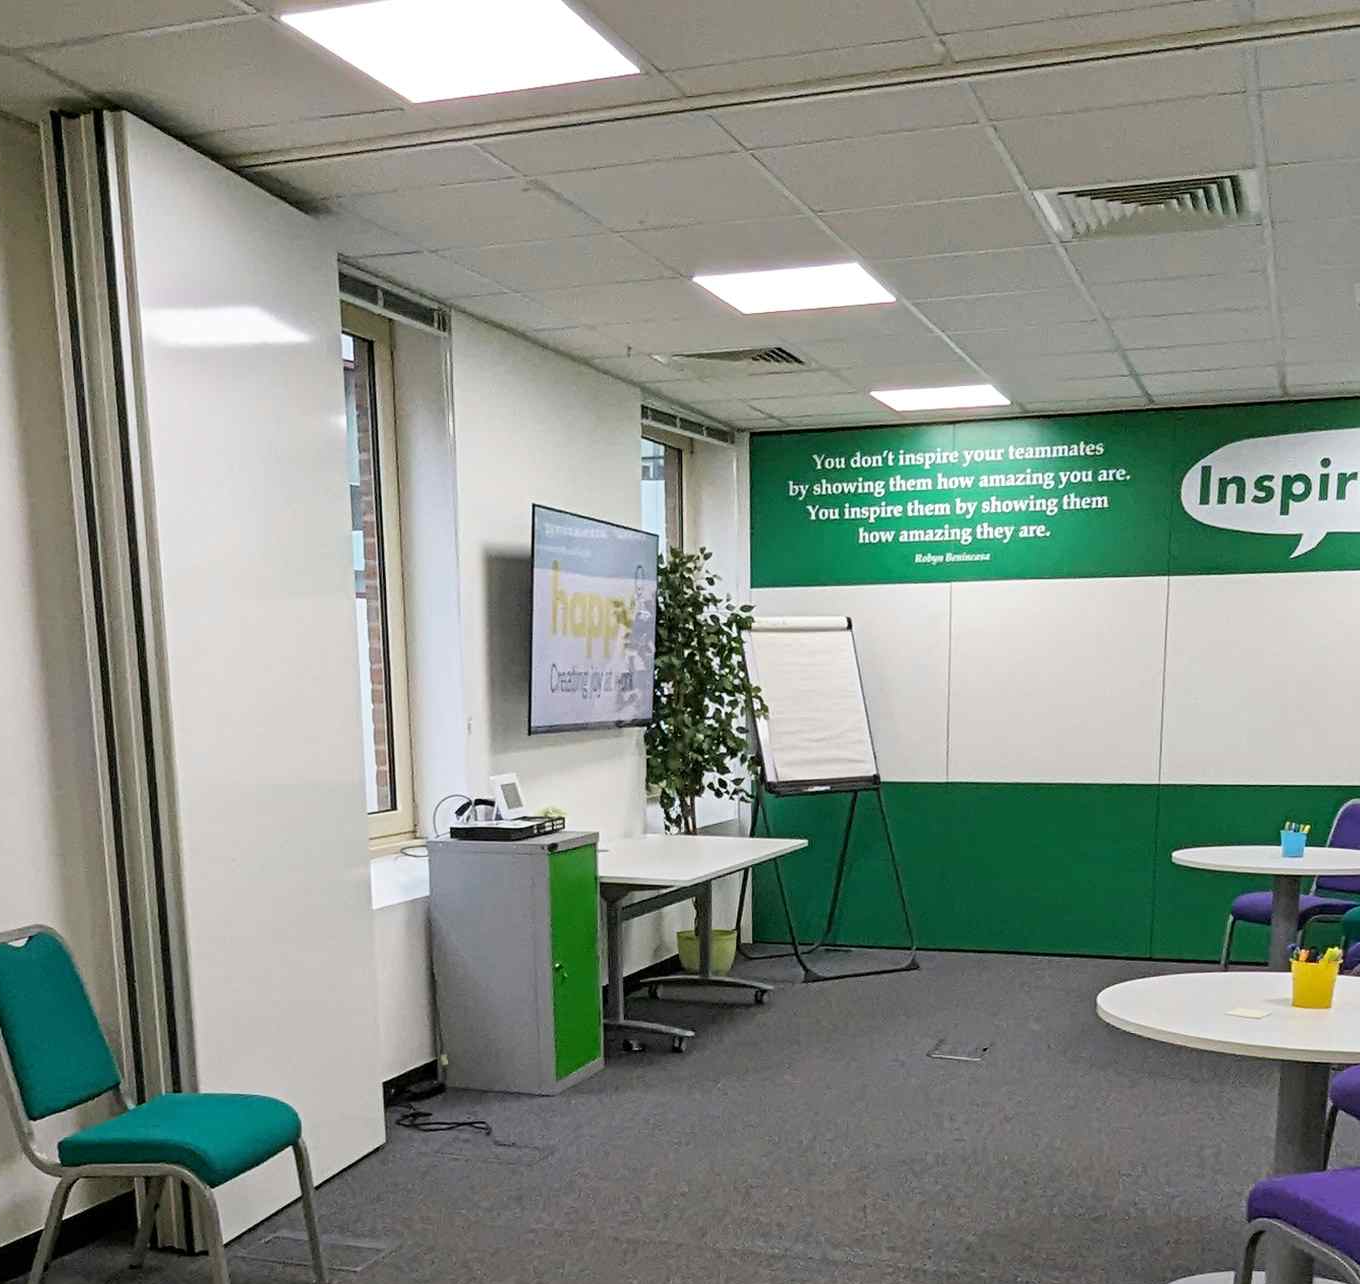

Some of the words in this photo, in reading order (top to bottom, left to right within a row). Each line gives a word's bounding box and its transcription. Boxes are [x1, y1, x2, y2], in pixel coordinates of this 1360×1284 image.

[812, 453, 846, 470] You
[850, 451, 895, 468] don't
[899, 448, 959, 469] inspire
[962, 447, 1004, 467] your
[1008, 441, 1105, 460] teammates
[788, 480, 809, 498] by
[812, 478, 885, 498] showing
[889, 476, 933, 492] them
[937, 474, 975, 491] how
[979, 471, 1056, 490] amazing
[1058, 469, 1092, 488] you
[1098, 467, 1131, 482] are.
[806, 505, 840, 521] You
[844, 502, 903, 522] inspire
[907, 499, 951, 516] them
[955, 497, 977, 517] by
[981, 495, 1058, 516] showing
[1062, 494, 1109, 510] them
[858, 527, 895, 545] how
[898, 526, 972, 545] amazing
[976, 523, 1014, 543] they
[1018, 522, 1051, 538] are.
